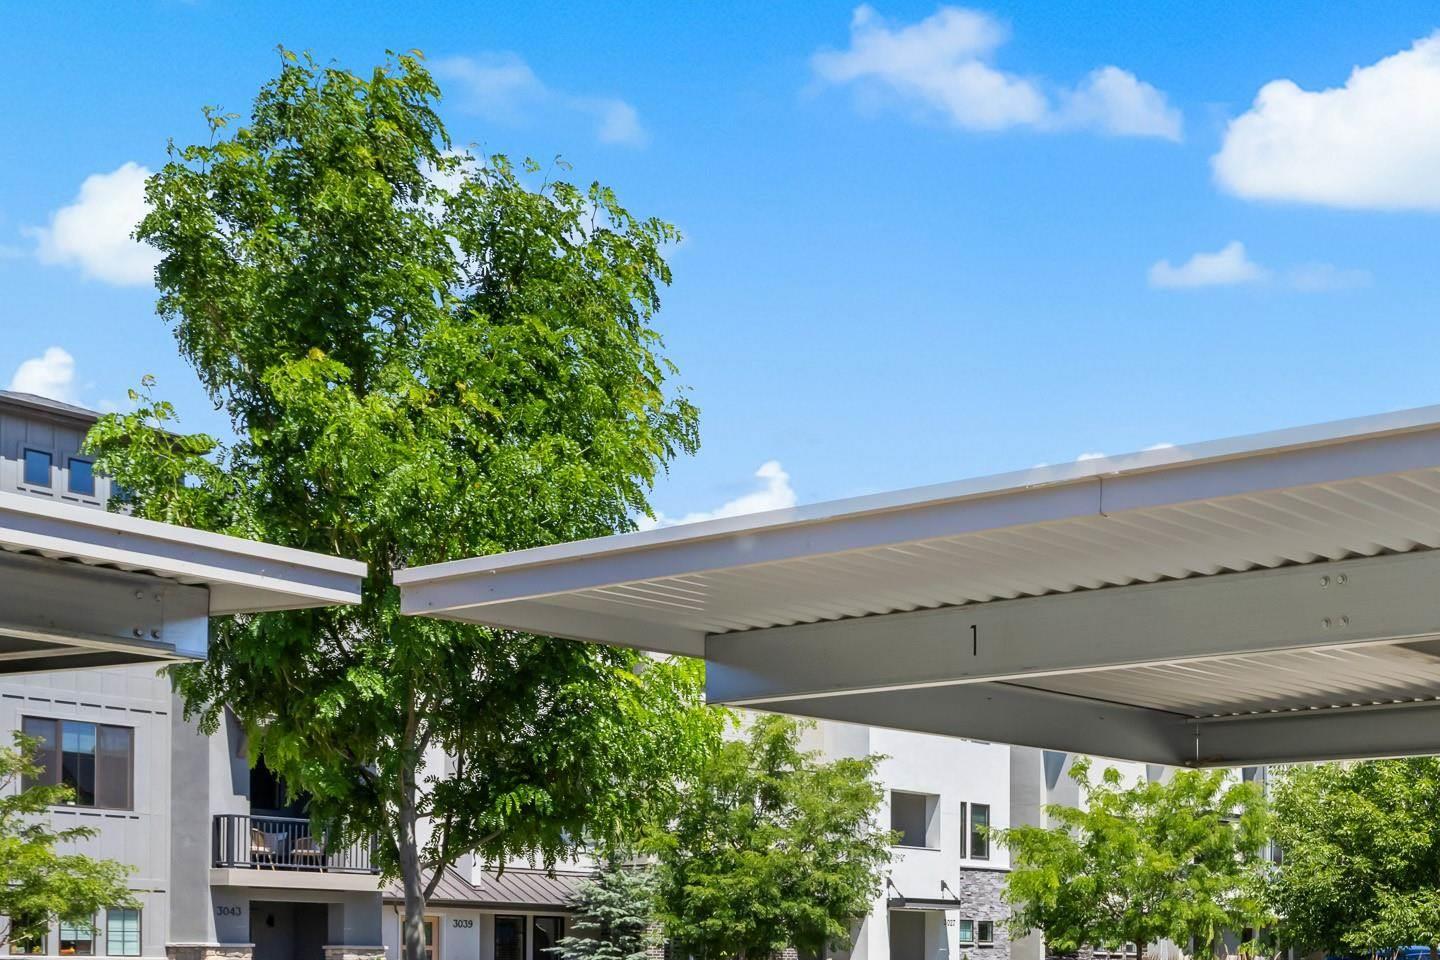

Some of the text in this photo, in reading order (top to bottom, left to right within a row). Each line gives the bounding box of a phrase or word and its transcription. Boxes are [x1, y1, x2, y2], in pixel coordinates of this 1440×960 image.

[969, 624, 977, 656] 1
[216, 905, 242, 916] 3043
[452, 919, 473, 928] 3039
